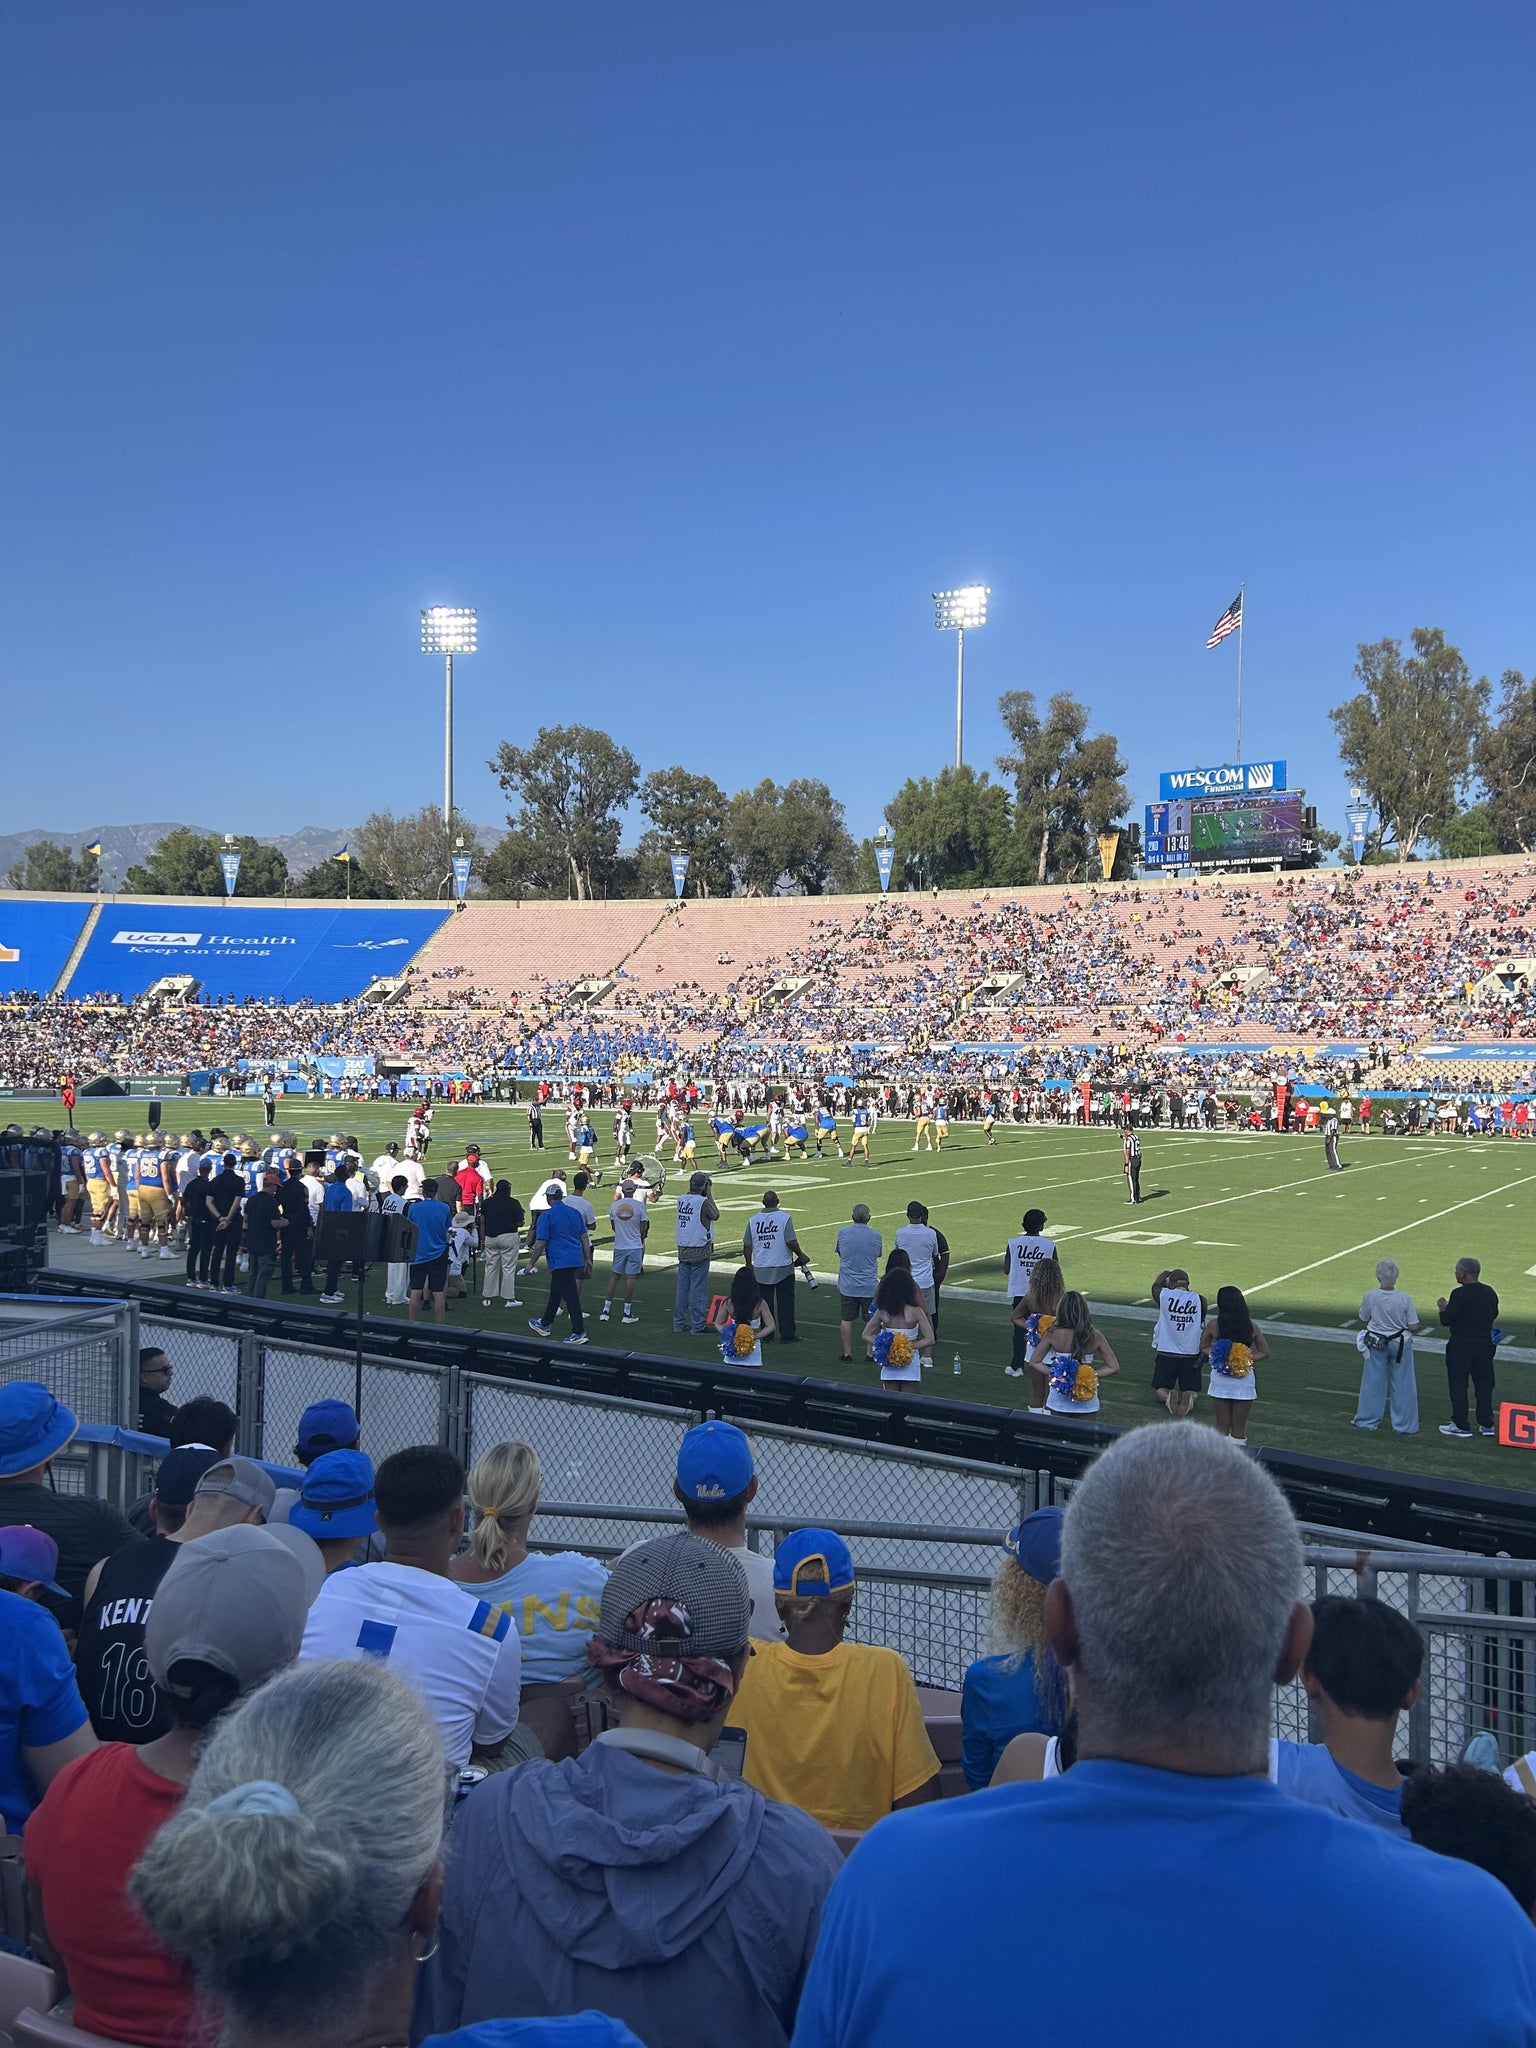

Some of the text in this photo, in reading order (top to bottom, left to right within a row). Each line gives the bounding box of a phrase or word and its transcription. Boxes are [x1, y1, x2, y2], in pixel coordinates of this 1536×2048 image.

[1170, 767, 1244, 789] WESCOM
[1204, 783, 1244, 793] Financial
[1167, 836, 1189, 851] 13:43
[1250, 856, 1283, 864] FOUNDATION
[127, 934, 297, 946] UCLA Health
[128, 946, 272, 957] Keep on rising
[247, 1060, 278, 1069] WESCOM
[344, 1060, 367, 1069] SEAT
[343, 1068, 367, 1079] GEEK
[678, 1201, 694, 1215] Ucla
[756, 1220, 779, 1235] Ucla
[758, 1234, 776, 1242] MEDIA
[1017, 1244, 1045, 1260] Ucla
[1020, 1260, 1034, 1268] MED
[1168, 1297, 1198, 1315] Ucla
[1170, 1314, 1194, 1323] MEDIA
[1176, 1322, 1186, 1332] 27
[1508, 1408, 1536, 1445] G
[695, 1483, 726, 1498] Ucla
[101, 1642, 157, 1728] 18
